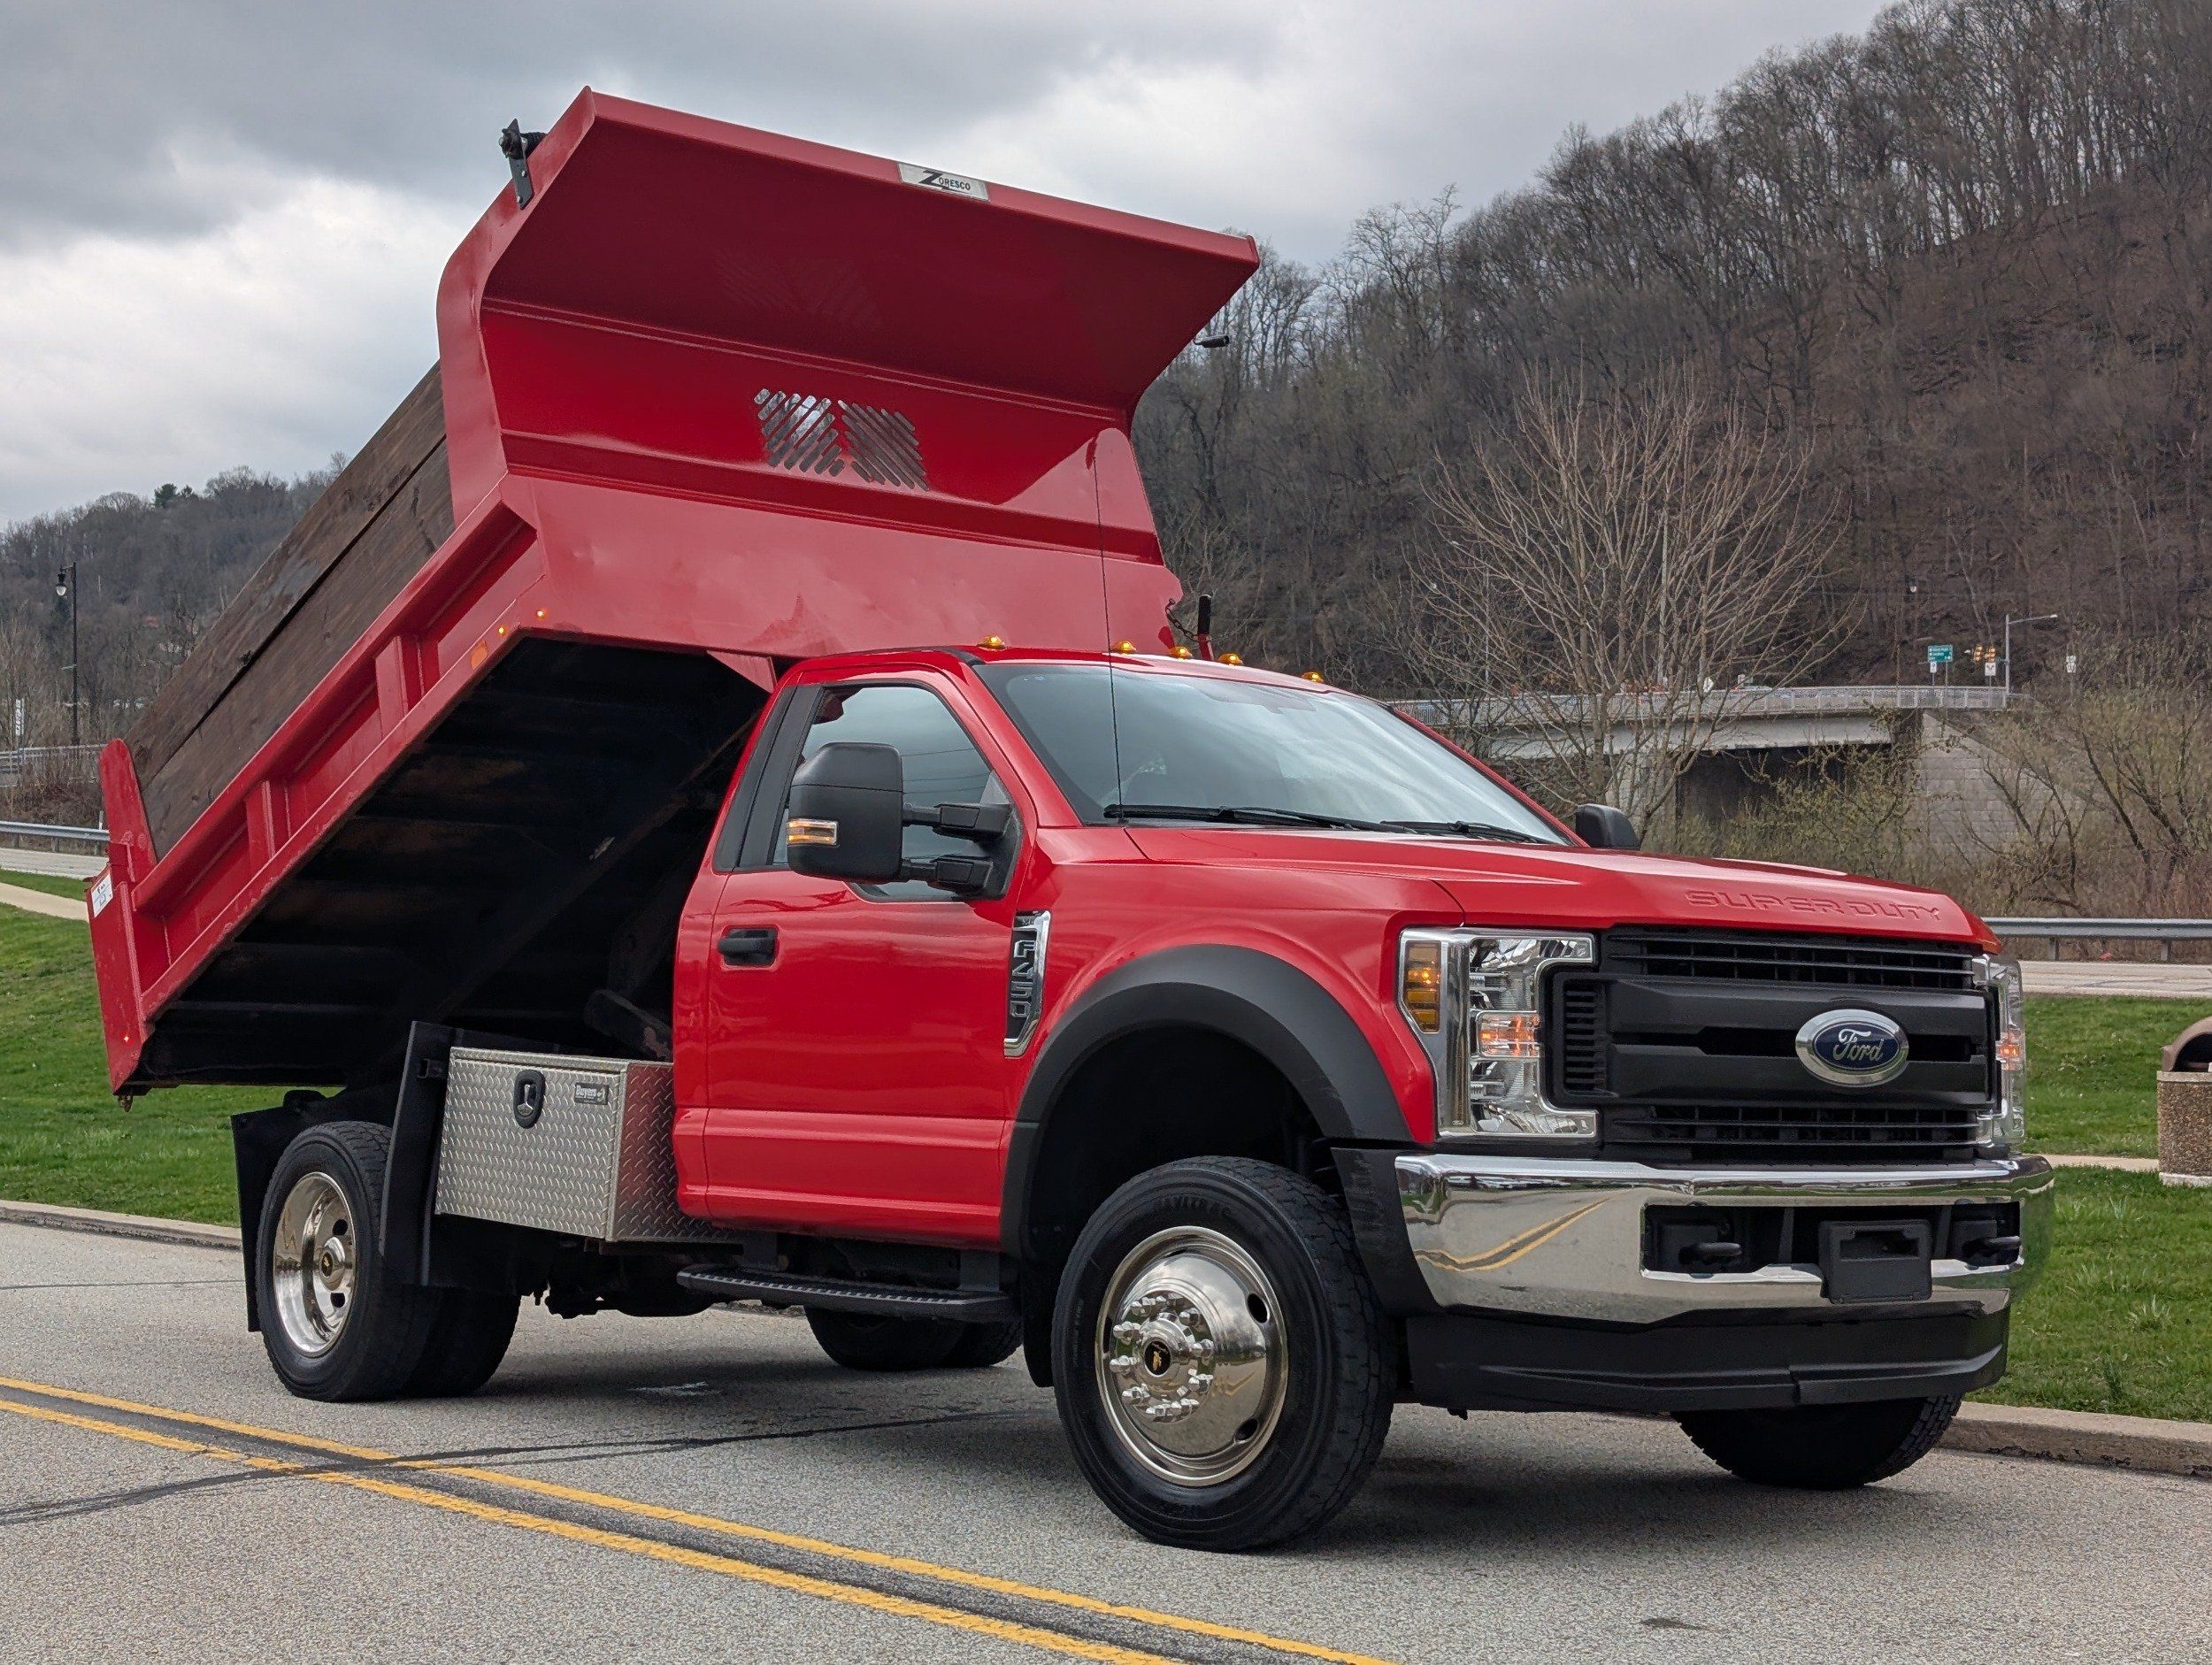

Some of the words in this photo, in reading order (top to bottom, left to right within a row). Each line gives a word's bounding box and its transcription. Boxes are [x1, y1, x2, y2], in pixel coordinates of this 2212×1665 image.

[918, 169, 971, 191] ZORESCO
[1685, 889, 1845, 914] SUPER
[1847, 900, 1941, 921] DUTY
[1832, 1028, 1885, 1062] Ford
[576, 1085, 597, 1098] Buyers
